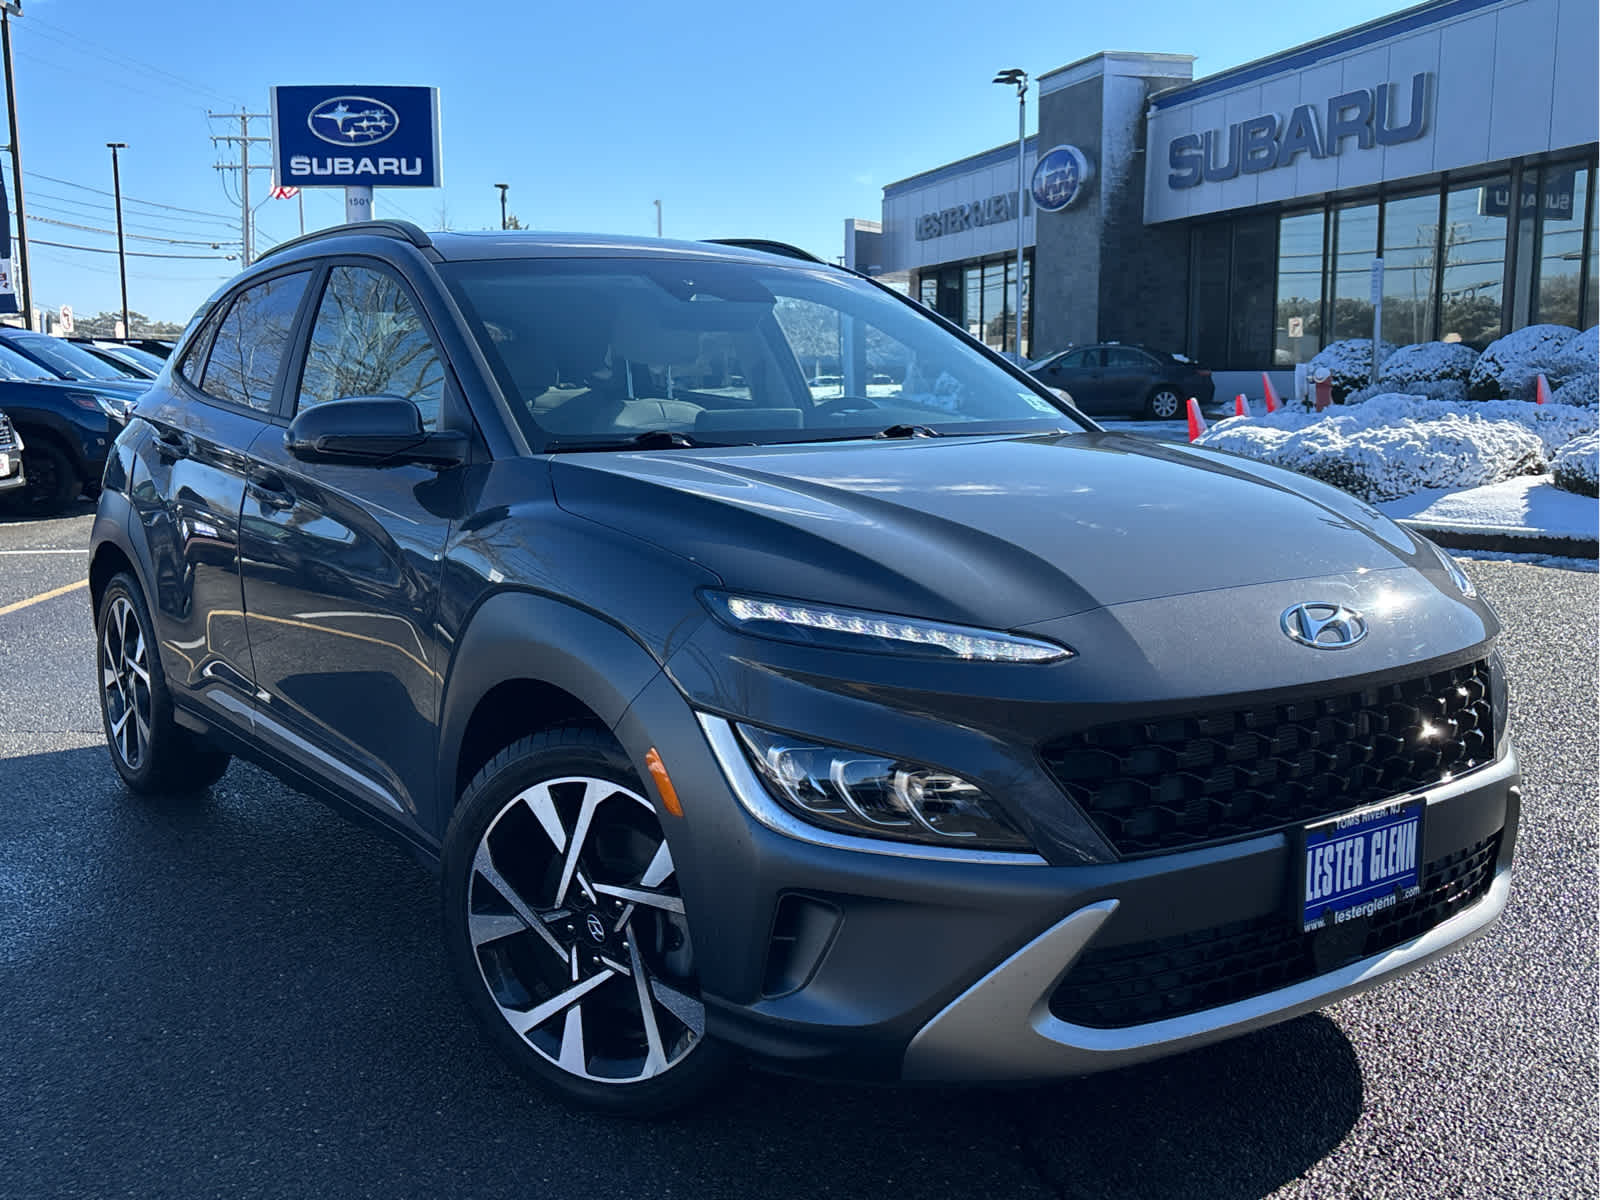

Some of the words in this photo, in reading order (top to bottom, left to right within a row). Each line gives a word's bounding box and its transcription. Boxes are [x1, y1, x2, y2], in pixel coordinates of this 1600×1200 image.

[1168, 72, 1428, 190] SUBARU
[290, 155, 422, 176] SUBARU
[915, 204, 969, 241] LESTER
[1336, 815, 1361, 830] TOMS
[1305, 836, 1365, 902] LESTER
[1369, 820, 1418, 882] GLENN
